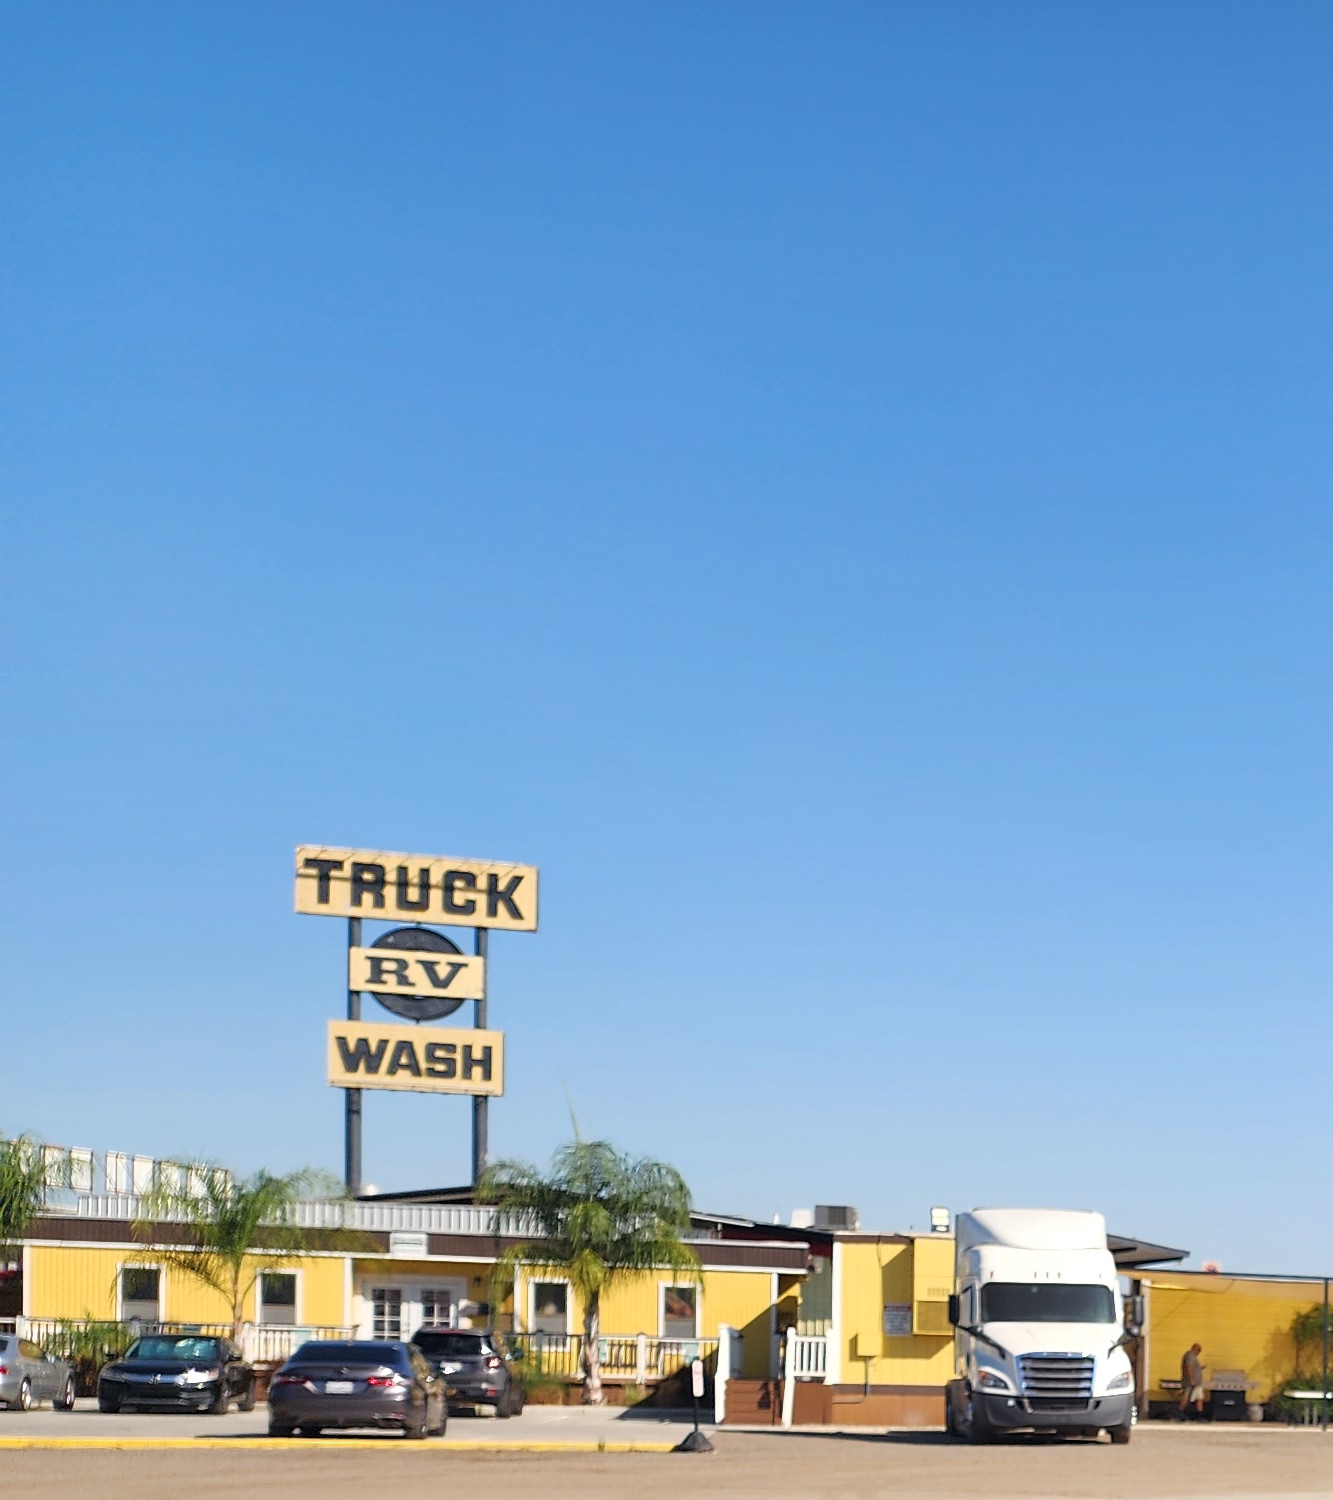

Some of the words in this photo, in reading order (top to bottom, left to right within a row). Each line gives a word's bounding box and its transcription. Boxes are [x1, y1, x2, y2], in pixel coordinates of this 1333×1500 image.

[304, 858, 524, 920] TRUCK
[364, 956, 469, 989] RV
[335, 1036, 493, 1081] WASH
